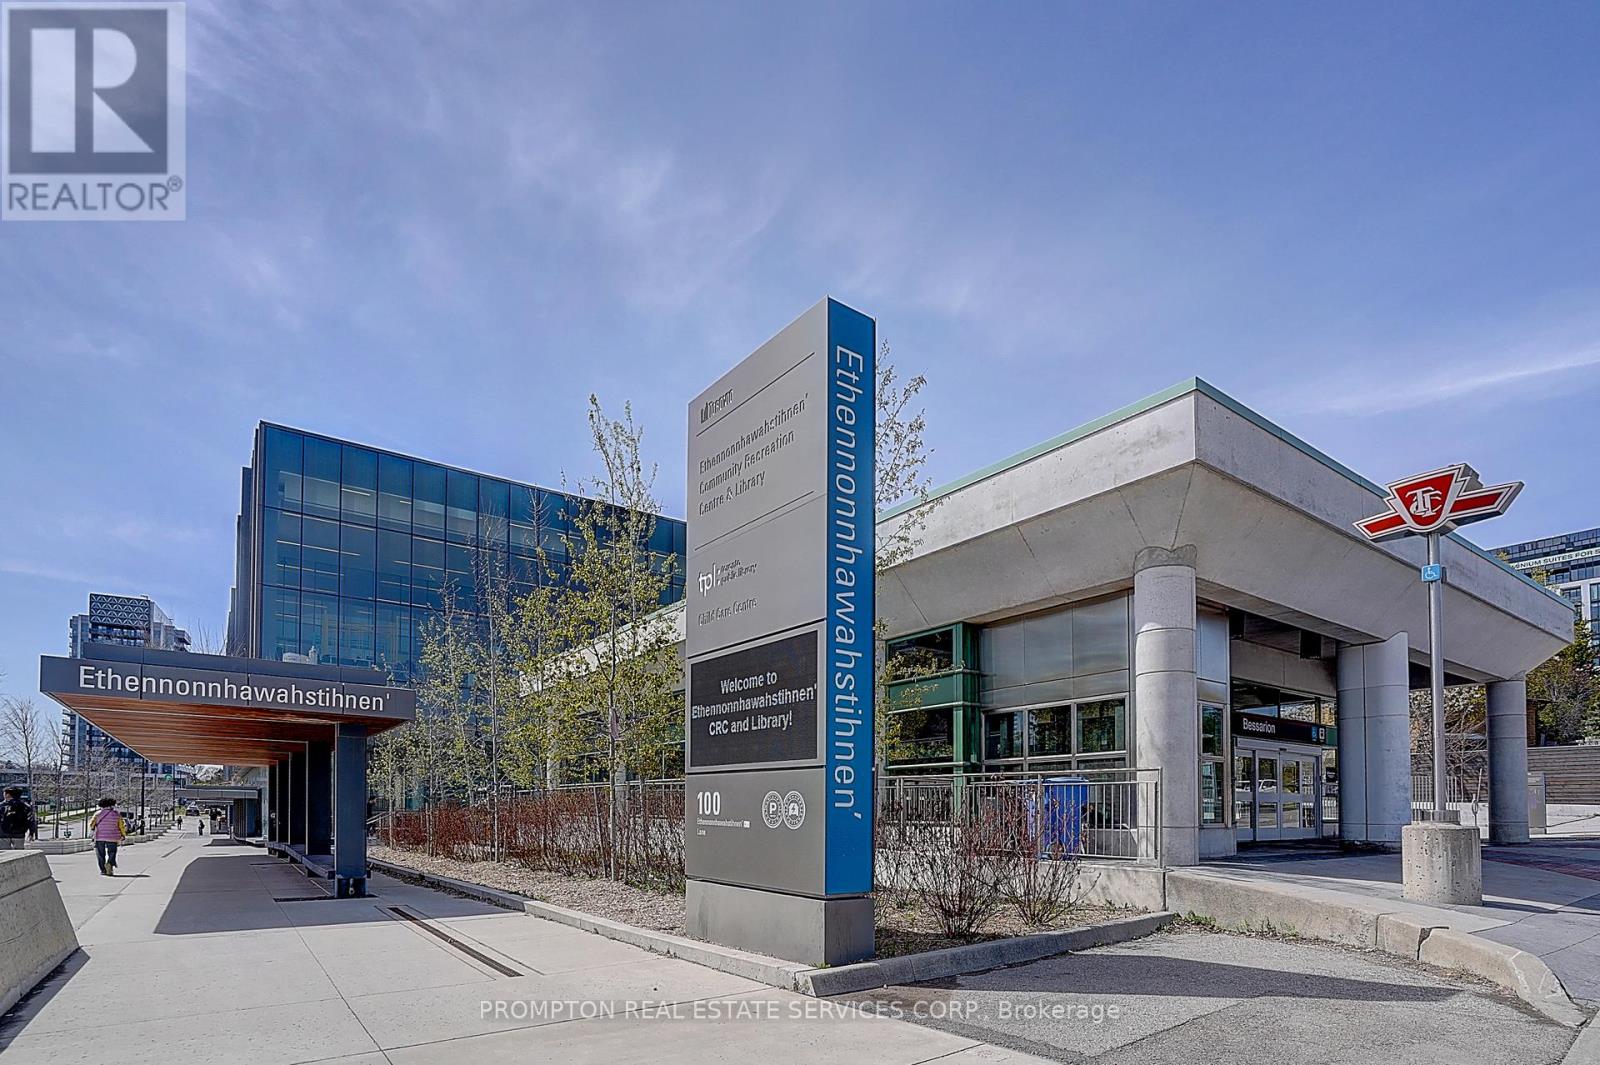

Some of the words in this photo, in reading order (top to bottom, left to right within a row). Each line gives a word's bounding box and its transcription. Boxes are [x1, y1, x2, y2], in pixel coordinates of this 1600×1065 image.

[700, 462, 742, 495] Community
[744, 430, 794, 469] Recreation
[700, 495, 724, 516] Centre
[726, 486, 733, 501] &
[735, 471, 765, 497] Library
[1543, 553, 1573, 564] SUITES
[1574, 550, 1593, 558] FOR
[720, 674, 764, 694] Welcome
[766, 671, 777, 684] to
[709, 720, 729, 736] CRC
[731, 716, 749, 732] and
[751, 710, 793, 731] Library!
[1242, 717, 1276, 734] Bessarion
[697, 791, 721, 816] 100
